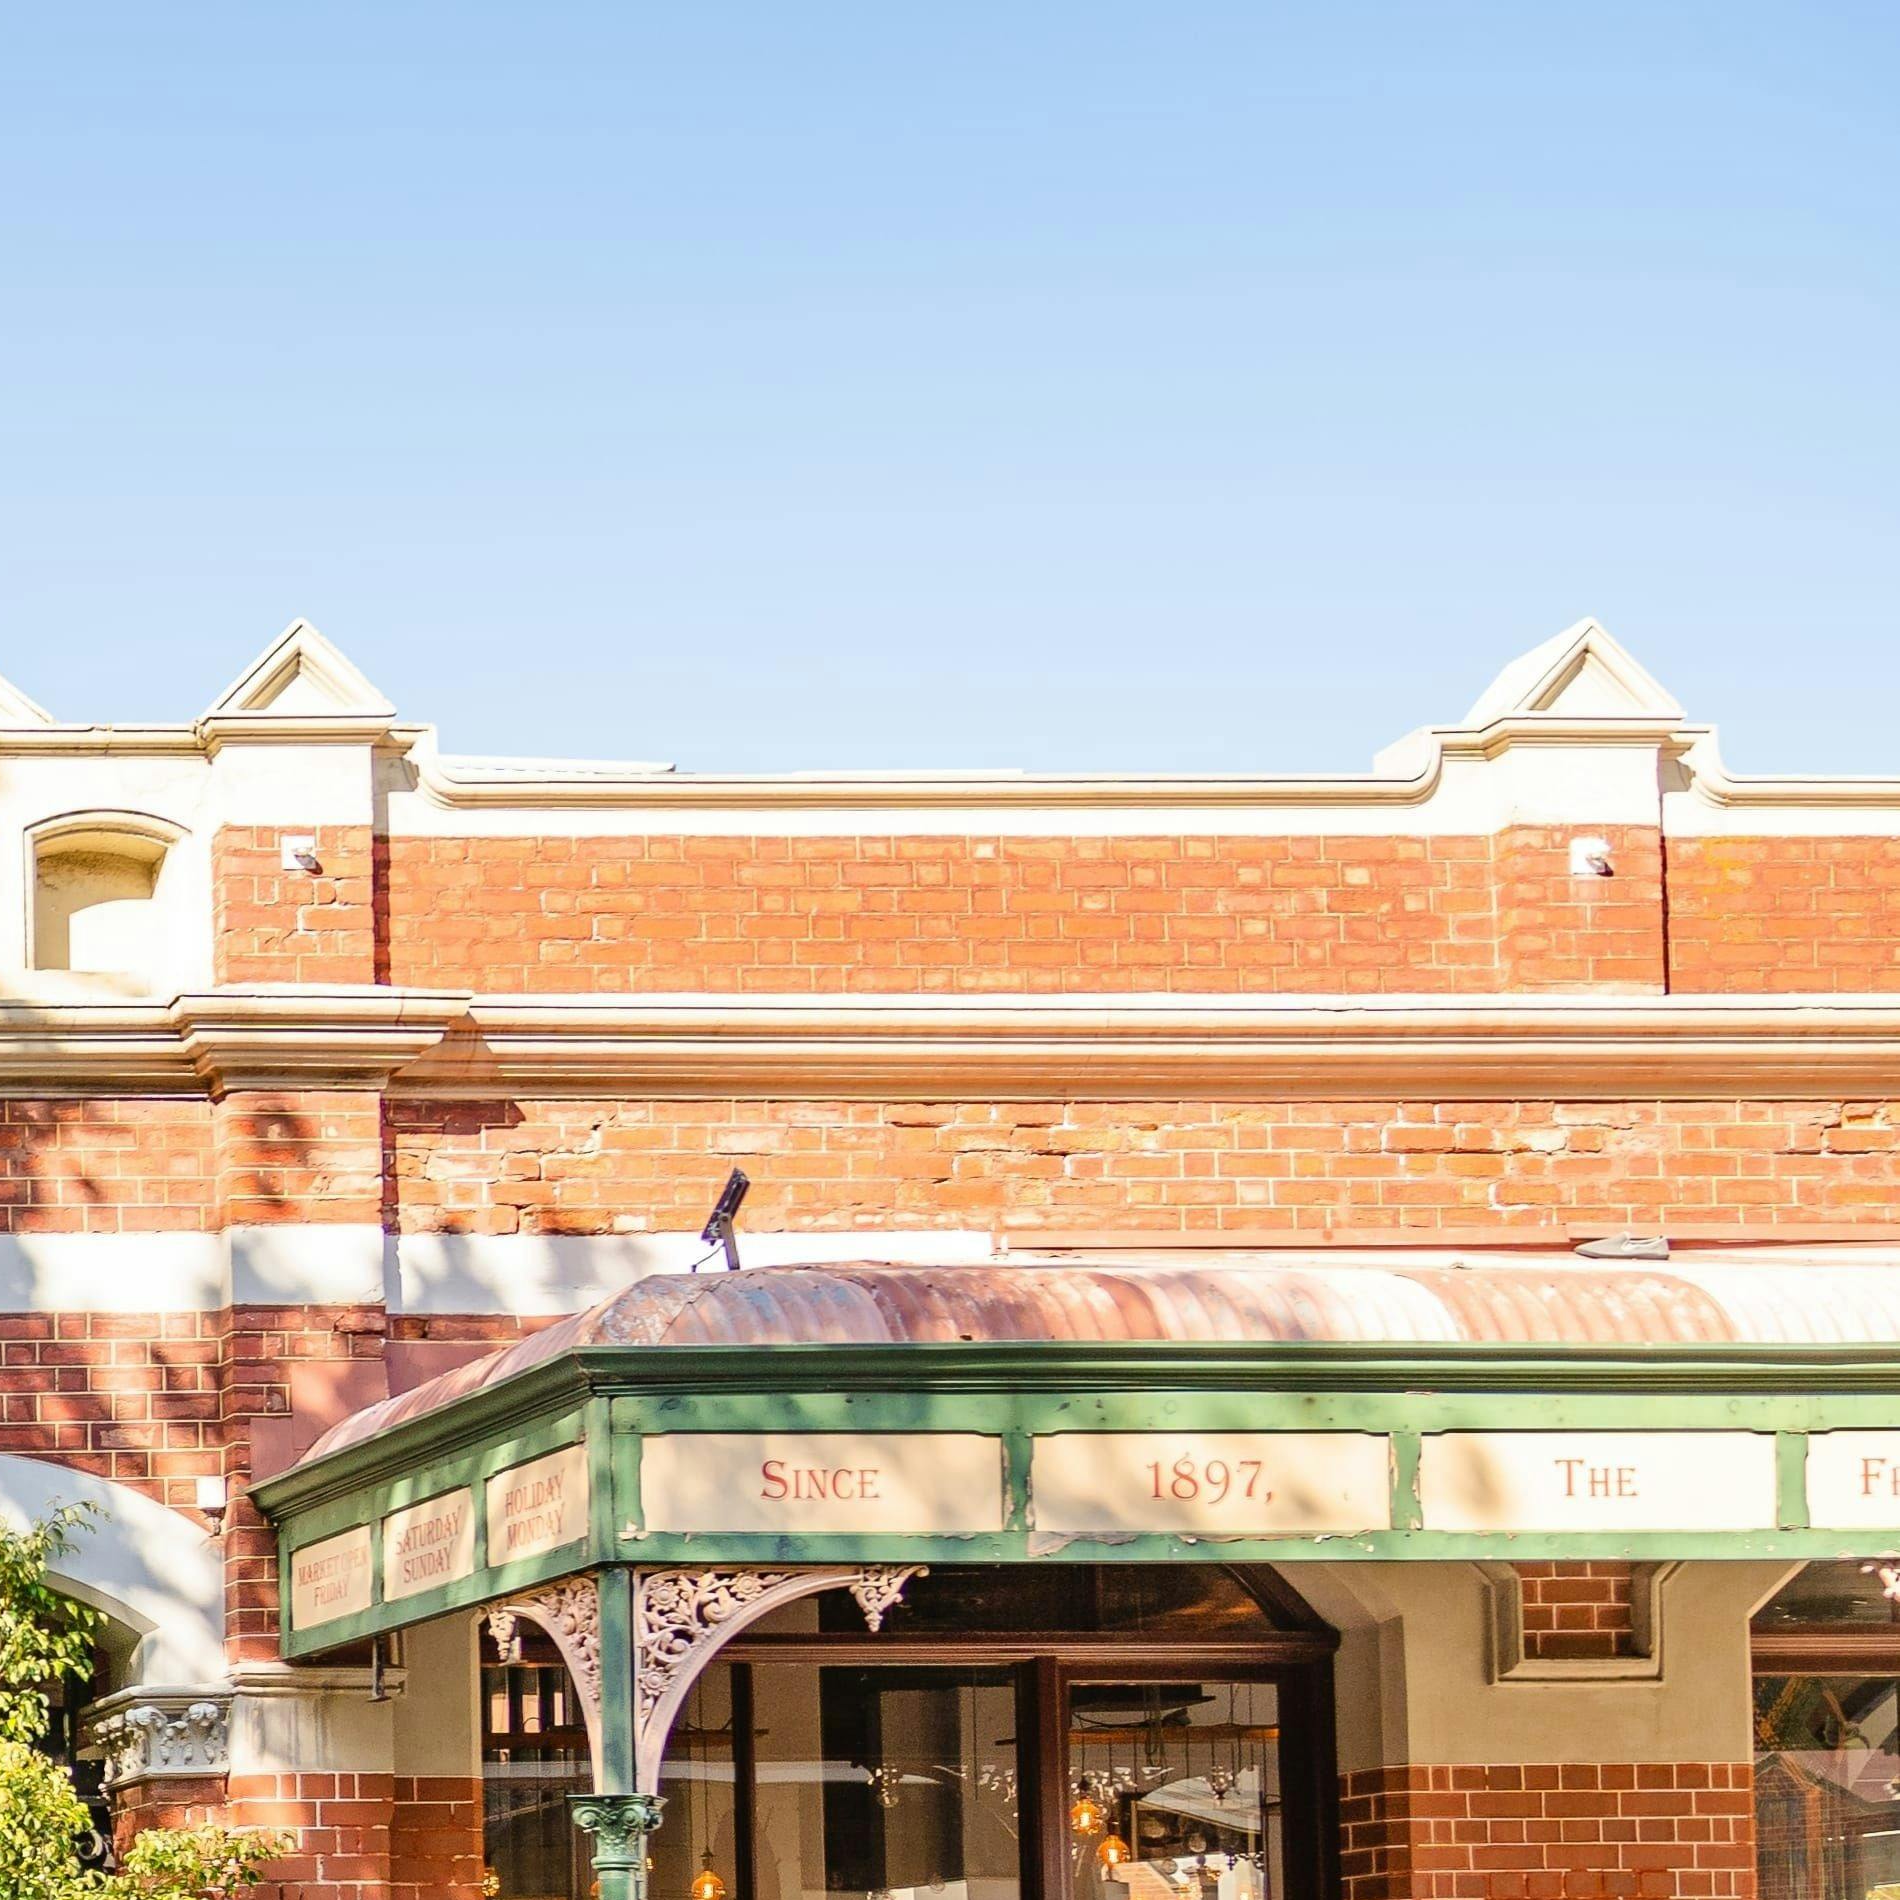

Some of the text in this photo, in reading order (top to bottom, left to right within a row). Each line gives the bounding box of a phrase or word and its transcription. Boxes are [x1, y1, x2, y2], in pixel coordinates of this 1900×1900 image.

[505, 1471, 565, 1515] HOLIDAY
[760, 1460, 880, 1502] SINCE
[1146, 1452, 1276, 1506] 1897,
[1554, 1458, 1638, 1497] THE
[396, 1508, 462, 1555] SATURDAY
[507, 1505, 565, 1550] MONDAY
[298, 1556, 338, 1588] MARKET
[403, 1543, 458, 1585] SUNDAY
[313, 1578, 348, 1608] FRIDAY
